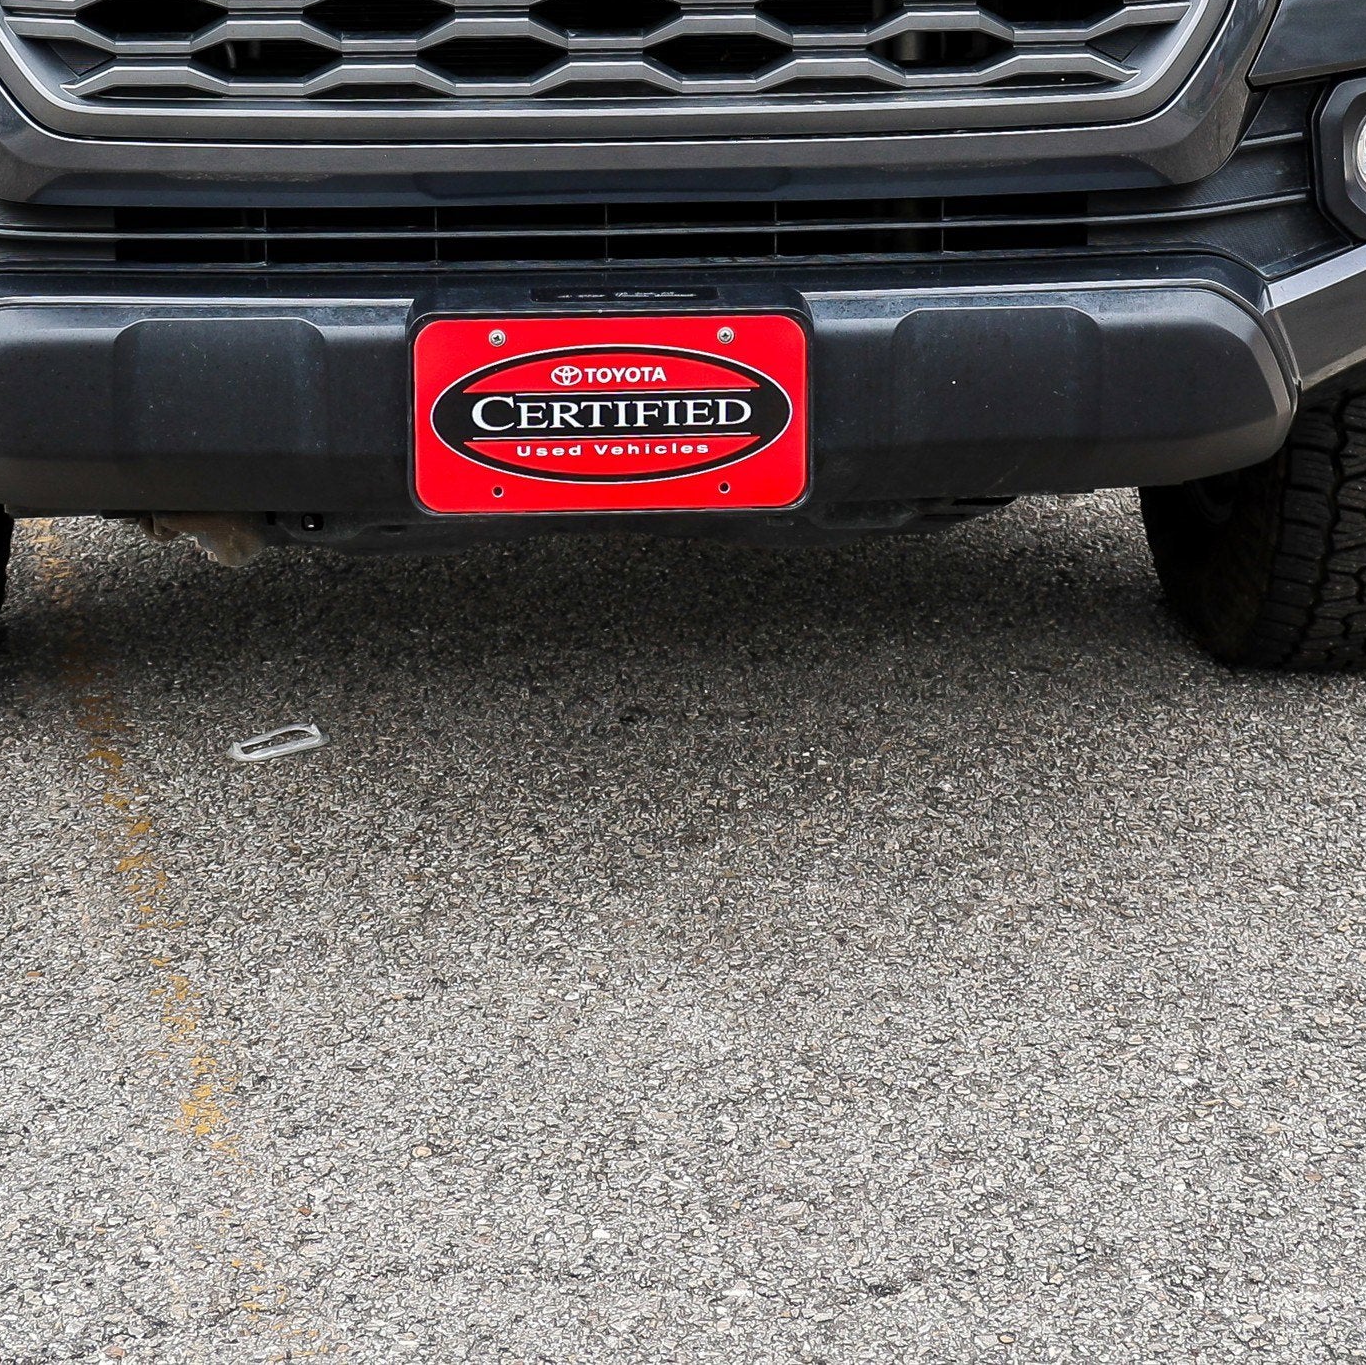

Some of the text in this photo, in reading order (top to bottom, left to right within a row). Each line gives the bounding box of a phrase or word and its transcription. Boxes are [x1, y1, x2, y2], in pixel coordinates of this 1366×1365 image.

[584, 366, 667, 383] TOYOTA
[471, 395, 752, 432] CERTIFIED
[516, 441, 710, 458] Used Vehicles
